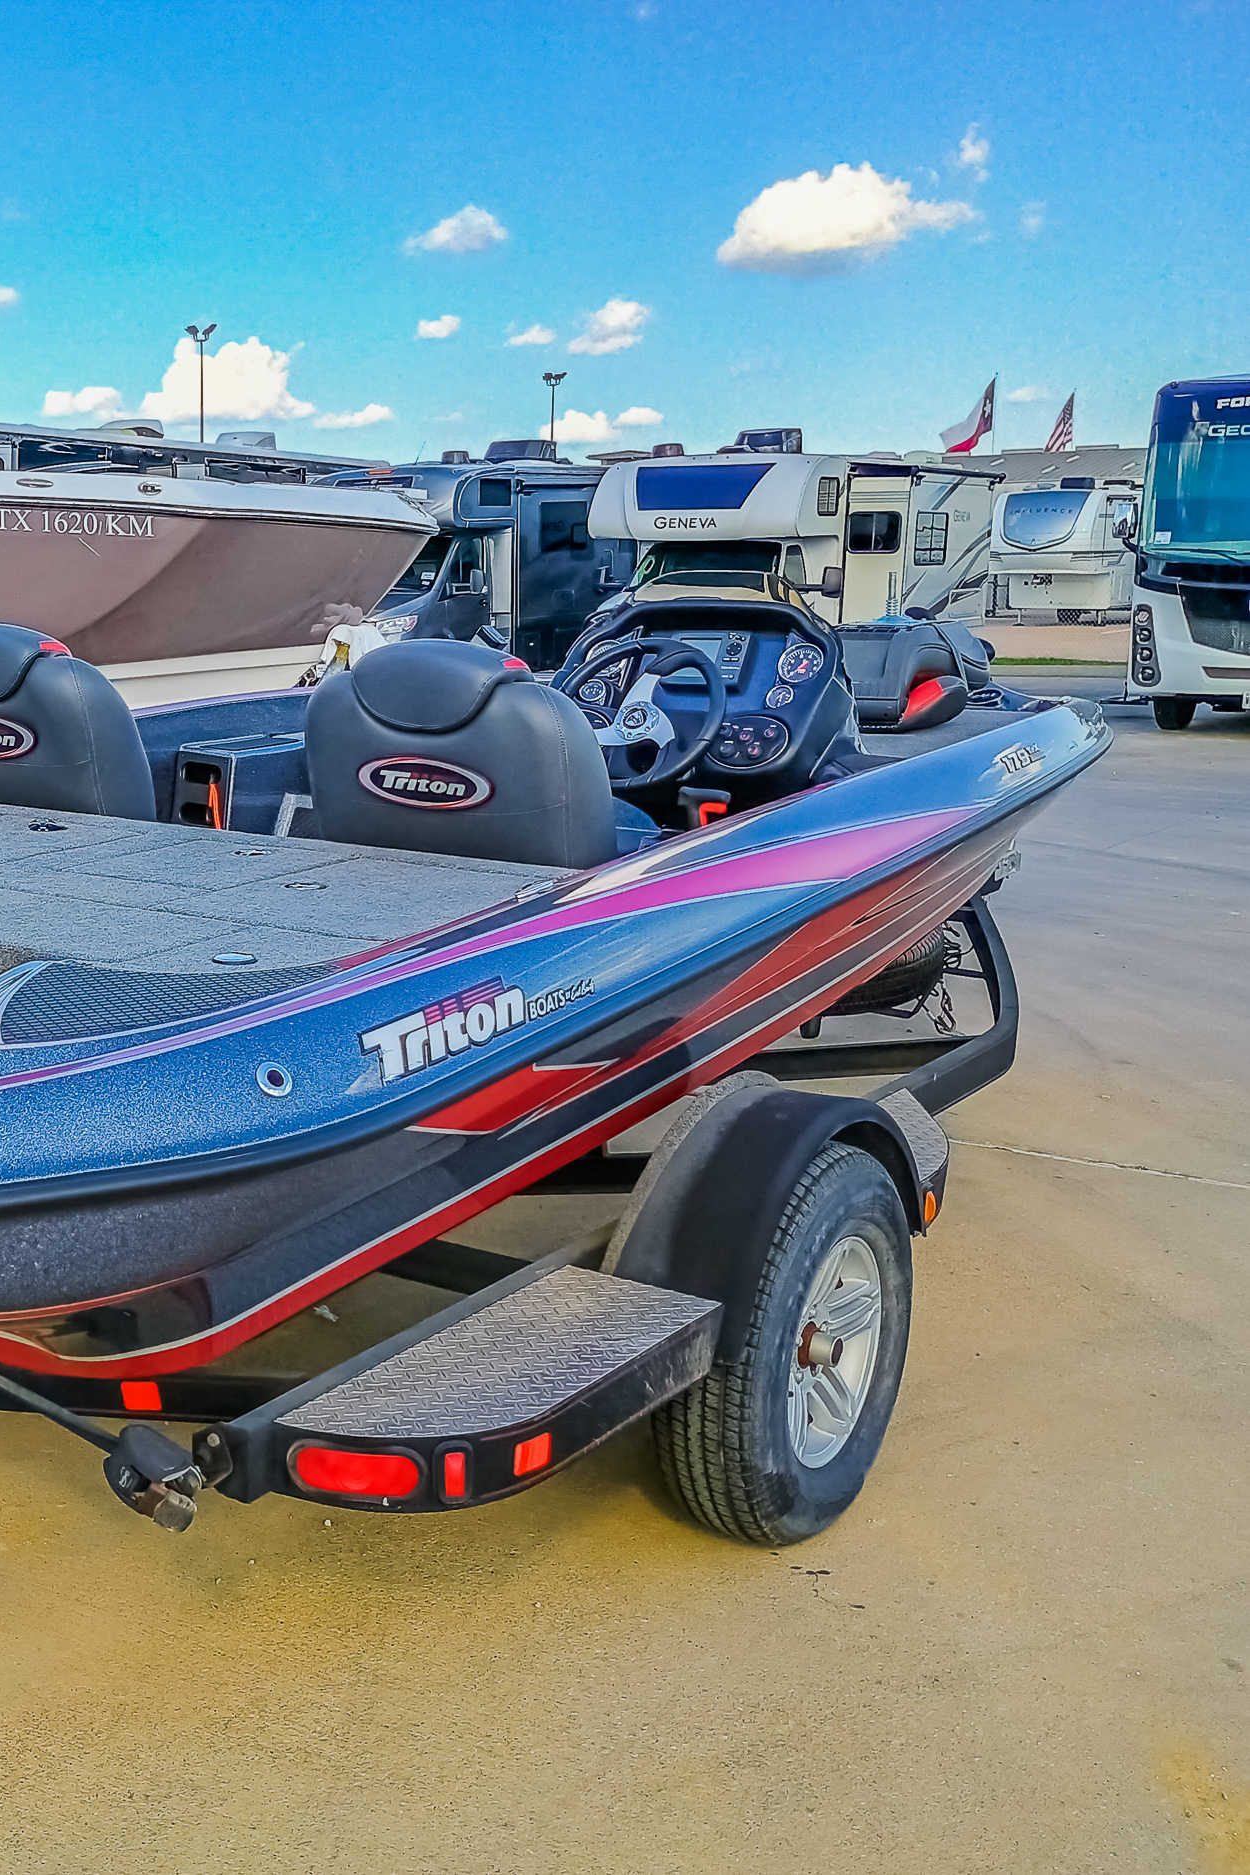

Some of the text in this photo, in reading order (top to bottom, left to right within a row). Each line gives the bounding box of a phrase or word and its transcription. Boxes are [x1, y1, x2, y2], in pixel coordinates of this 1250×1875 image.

[42, 510, 98, 535] 1620
[104, 513, 155, 537] KM
[654, 516, 718, 530] GENEVA
[379, 769, 466, 796] Triton
[360, 985, 566, 1083] Triton BOATS
